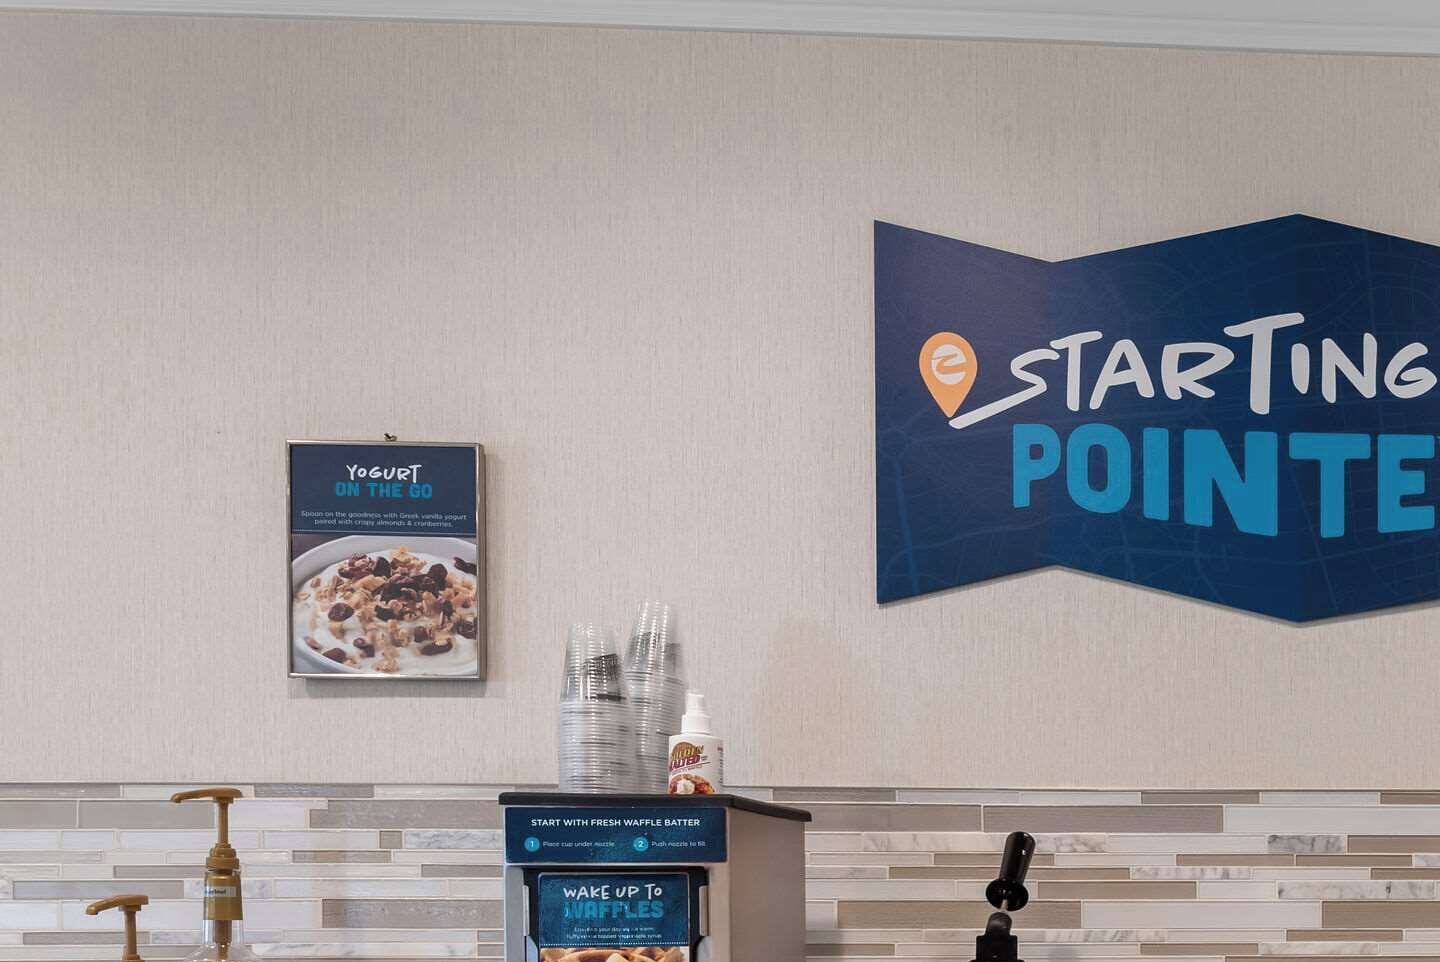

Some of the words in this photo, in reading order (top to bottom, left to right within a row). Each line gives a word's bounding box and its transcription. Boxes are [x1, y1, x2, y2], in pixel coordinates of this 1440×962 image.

[949, 312, 1437, 429] STARTING
[346, 464, 422, 484] YOGURT
[1012, 424, 1436, 539] POINTE
[335, 482, 360, 497] ON
[366, 482, 403, 498] THE
[409, 483, 433, 499] GO
[444, 513, 467, 521] yogurt
[531, 819, 561, 827] START
[563, 819, 589, 827] WITH
[590, 819, 621, 827] FRESH
[623, 819, 663, 827] WAFFLE
[664, 819, 701, 827] BATTER
[563, 885, 611, 900] WAKE
[616, 886, 640, 898] UP
[563, 901, 664, 919] WAFFLES
